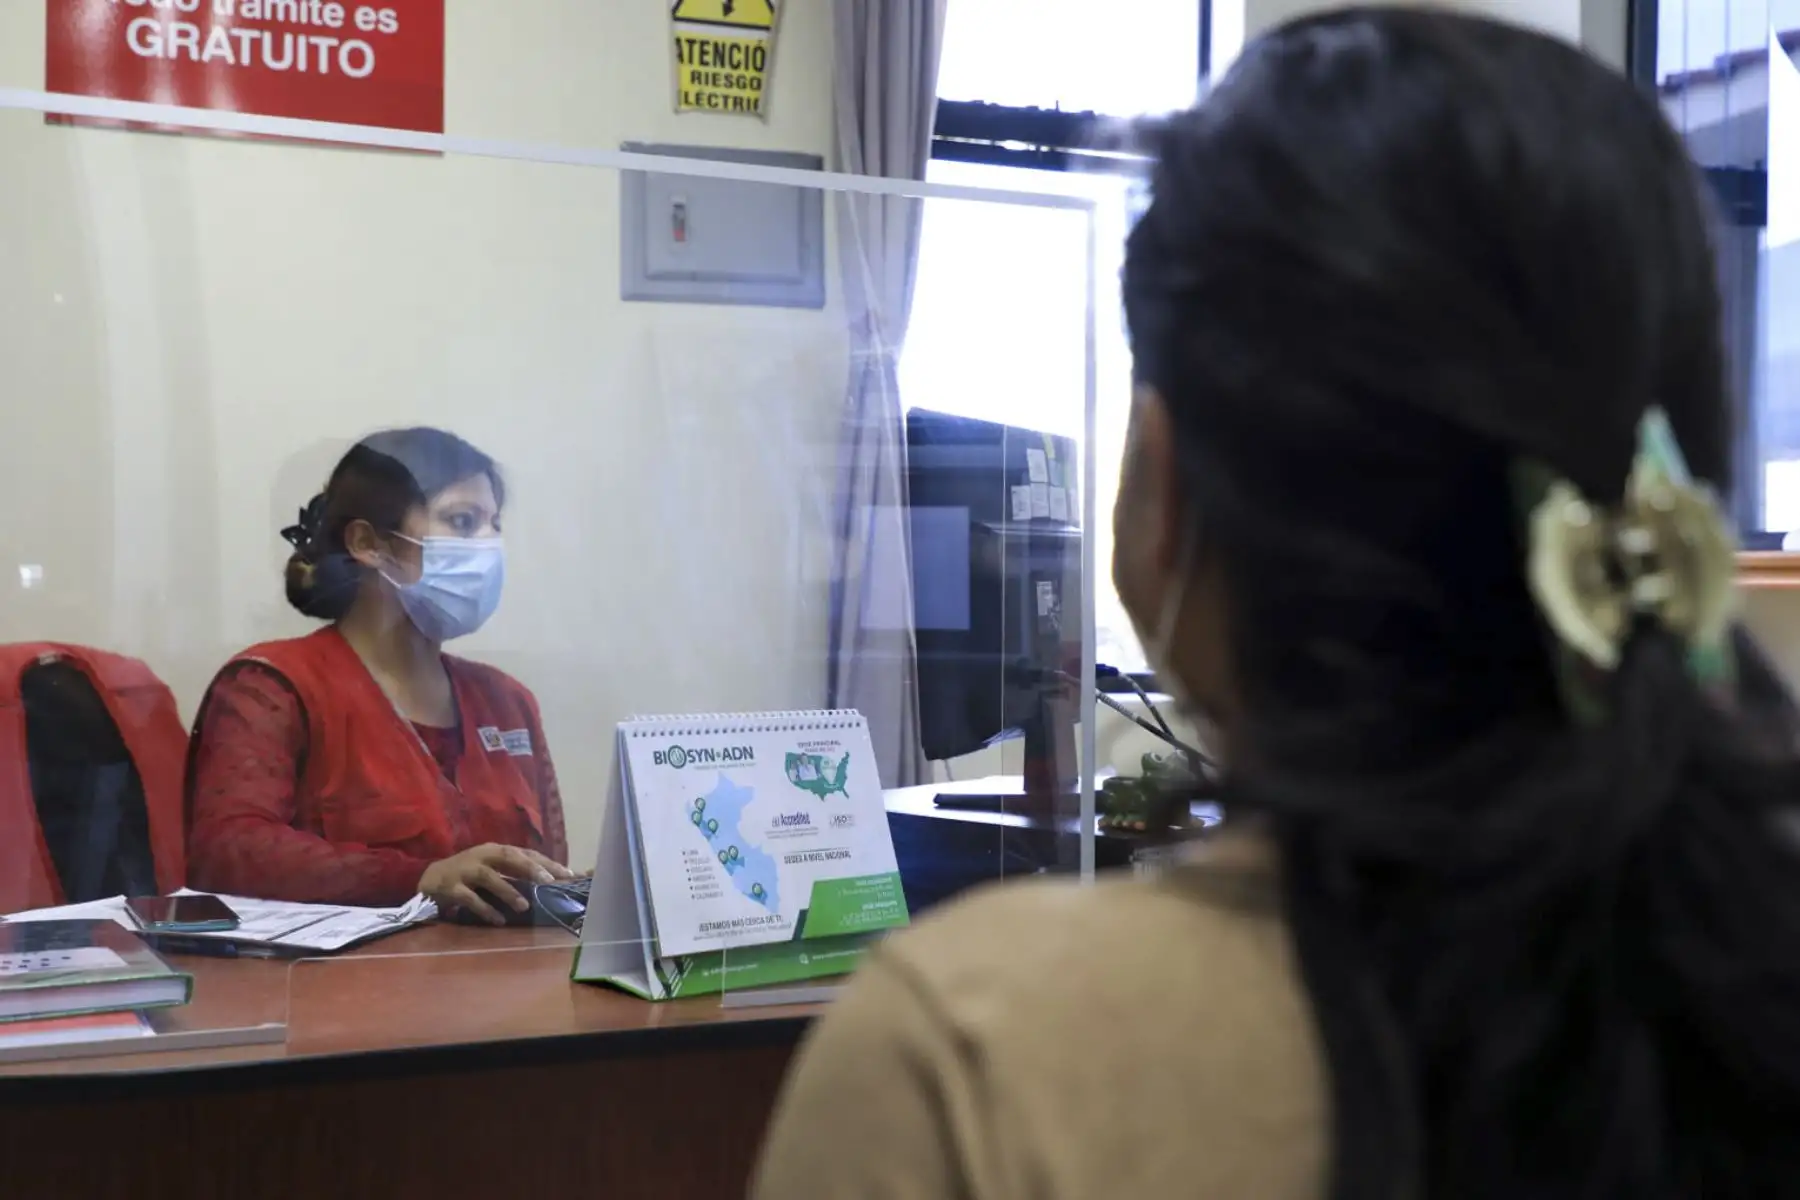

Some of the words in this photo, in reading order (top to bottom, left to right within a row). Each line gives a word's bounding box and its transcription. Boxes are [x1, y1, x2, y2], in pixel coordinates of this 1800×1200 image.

[354, 6, 399, 34] es
[126, 17, 375, 78] GRATUITO
[690, 69, 762, 91] RIESGO
